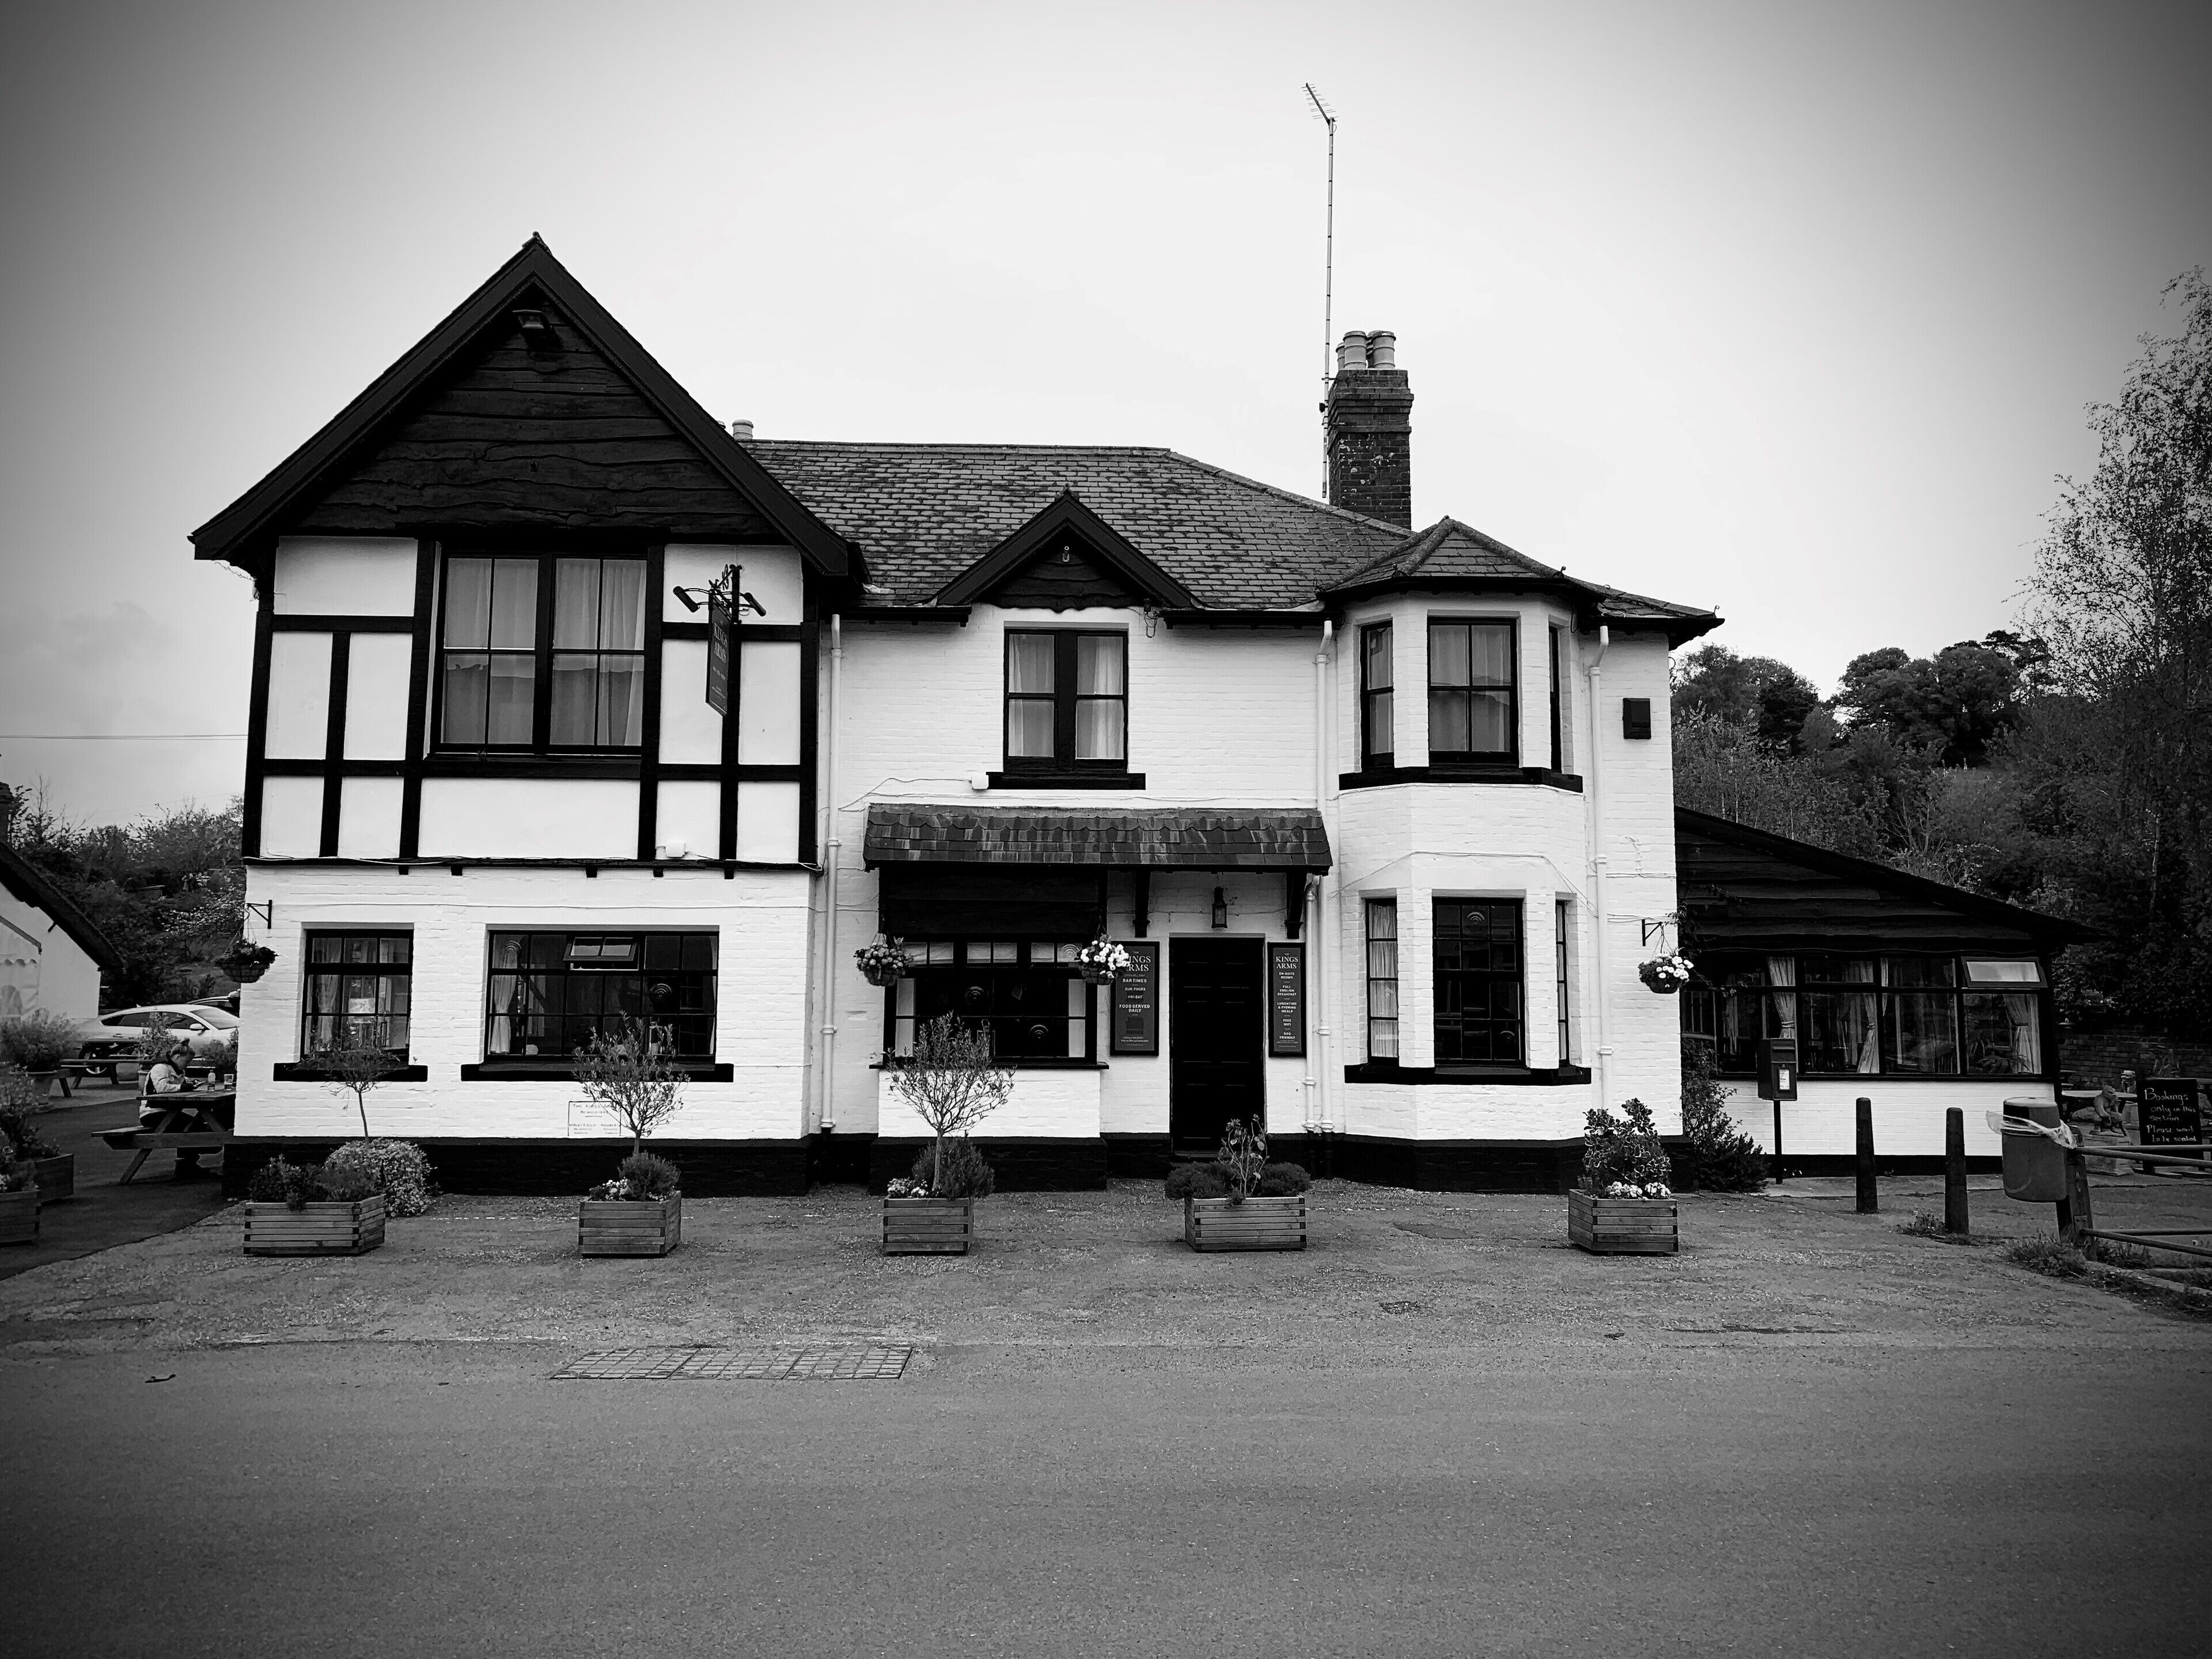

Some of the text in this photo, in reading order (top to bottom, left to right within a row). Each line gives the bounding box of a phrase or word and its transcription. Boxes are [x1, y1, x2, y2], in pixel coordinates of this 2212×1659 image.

[2144, 1088, 2188, 1105] Bookings
[2150, 1104, 2171, 1116] only
[2146, 1124, 2172, 1133] Please
